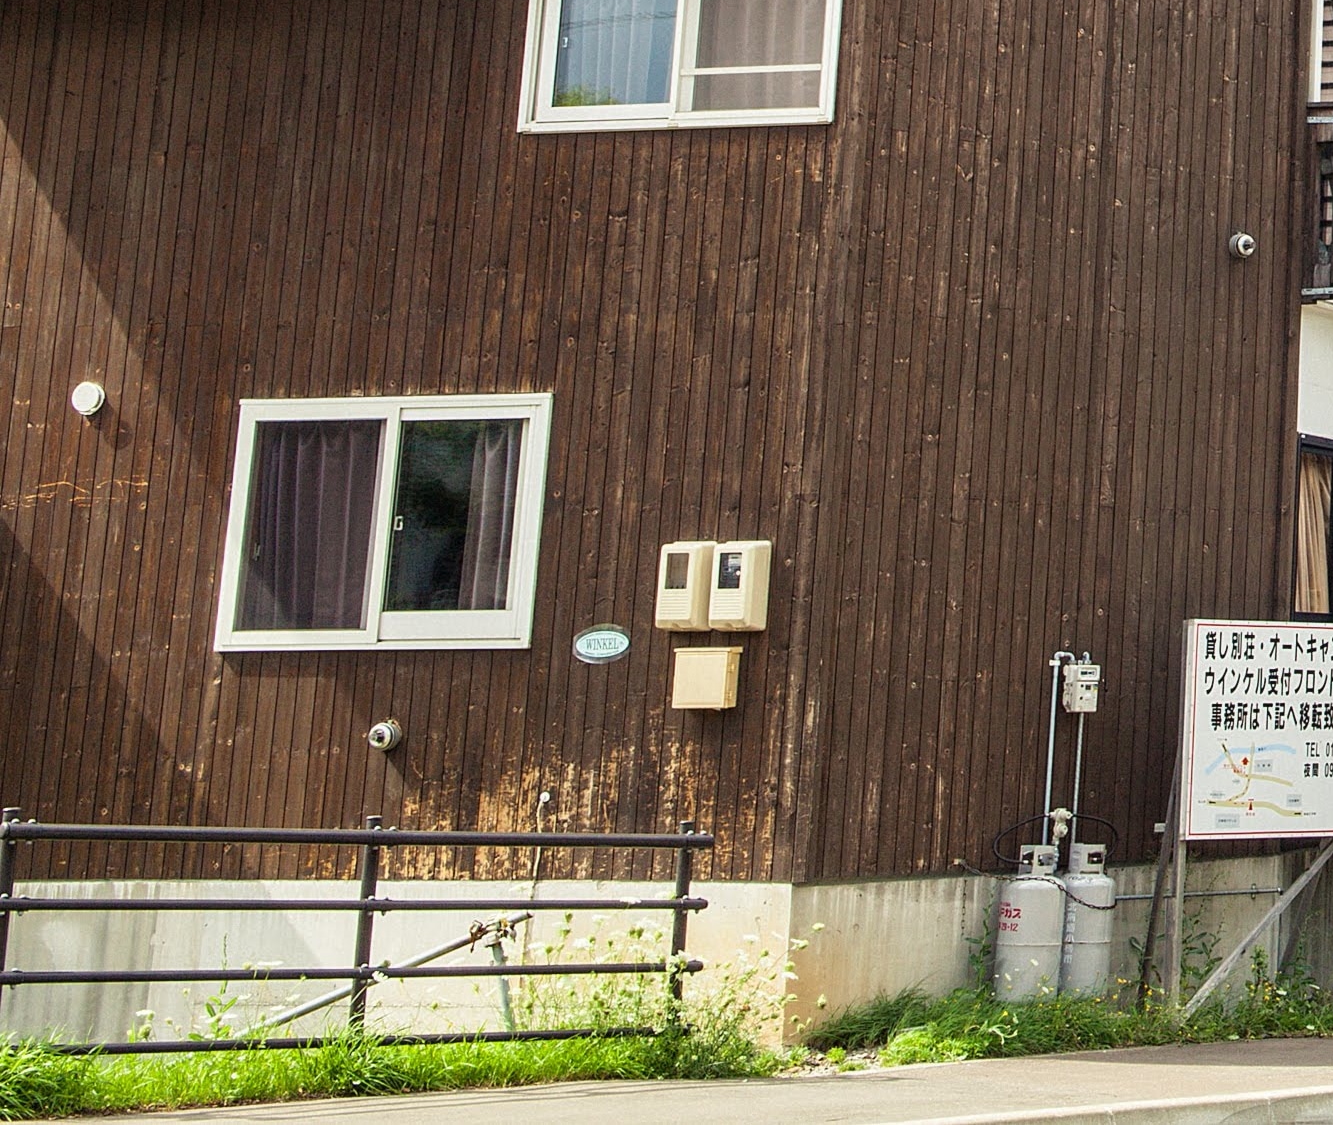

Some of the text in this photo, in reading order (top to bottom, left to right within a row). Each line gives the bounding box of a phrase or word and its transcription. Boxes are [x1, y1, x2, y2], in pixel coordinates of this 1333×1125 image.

[586, 638, 619, 650] WINKEL
[1305, 742, 1320, 757] TEL
[1304, 763, 1319, 777] 夜間
